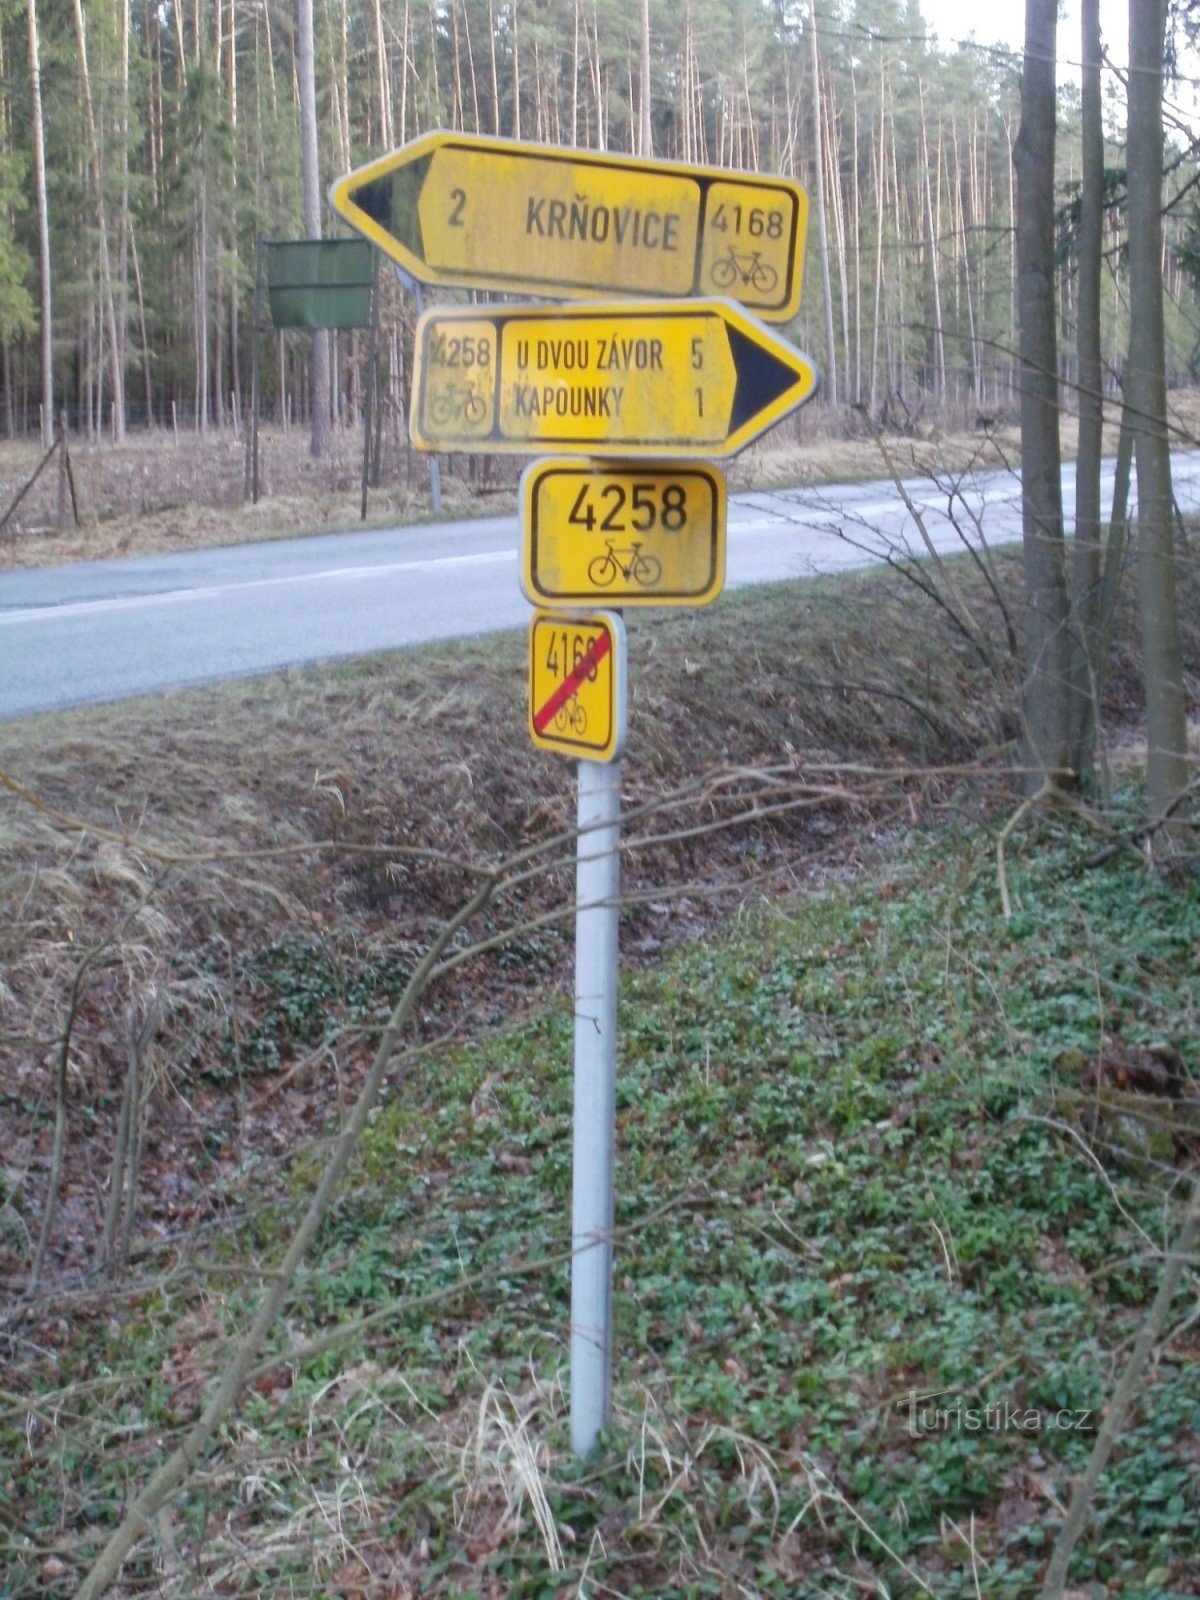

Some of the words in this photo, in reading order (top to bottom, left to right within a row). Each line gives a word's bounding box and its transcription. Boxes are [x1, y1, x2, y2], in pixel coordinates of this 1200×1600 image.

[447, 188, 468, 228] 2
[525, 192, 680, 252] KRŇOVICE
[711, 206, 785, 240] 4168
[430, 332, 491, 368] 4258
[517, 338, 530, 370] U
[536, 338, 591, 371] DVOU
[596, 333, 663, 371] ZÁVOR
[691, 338, 704, 370] 5
[514, 384, 624, 418] KAPOUNKY
[695, 387, 705, 419] 1
[568, 484, 688, 532] 4258
[547, 631, 598, 682] 4168
